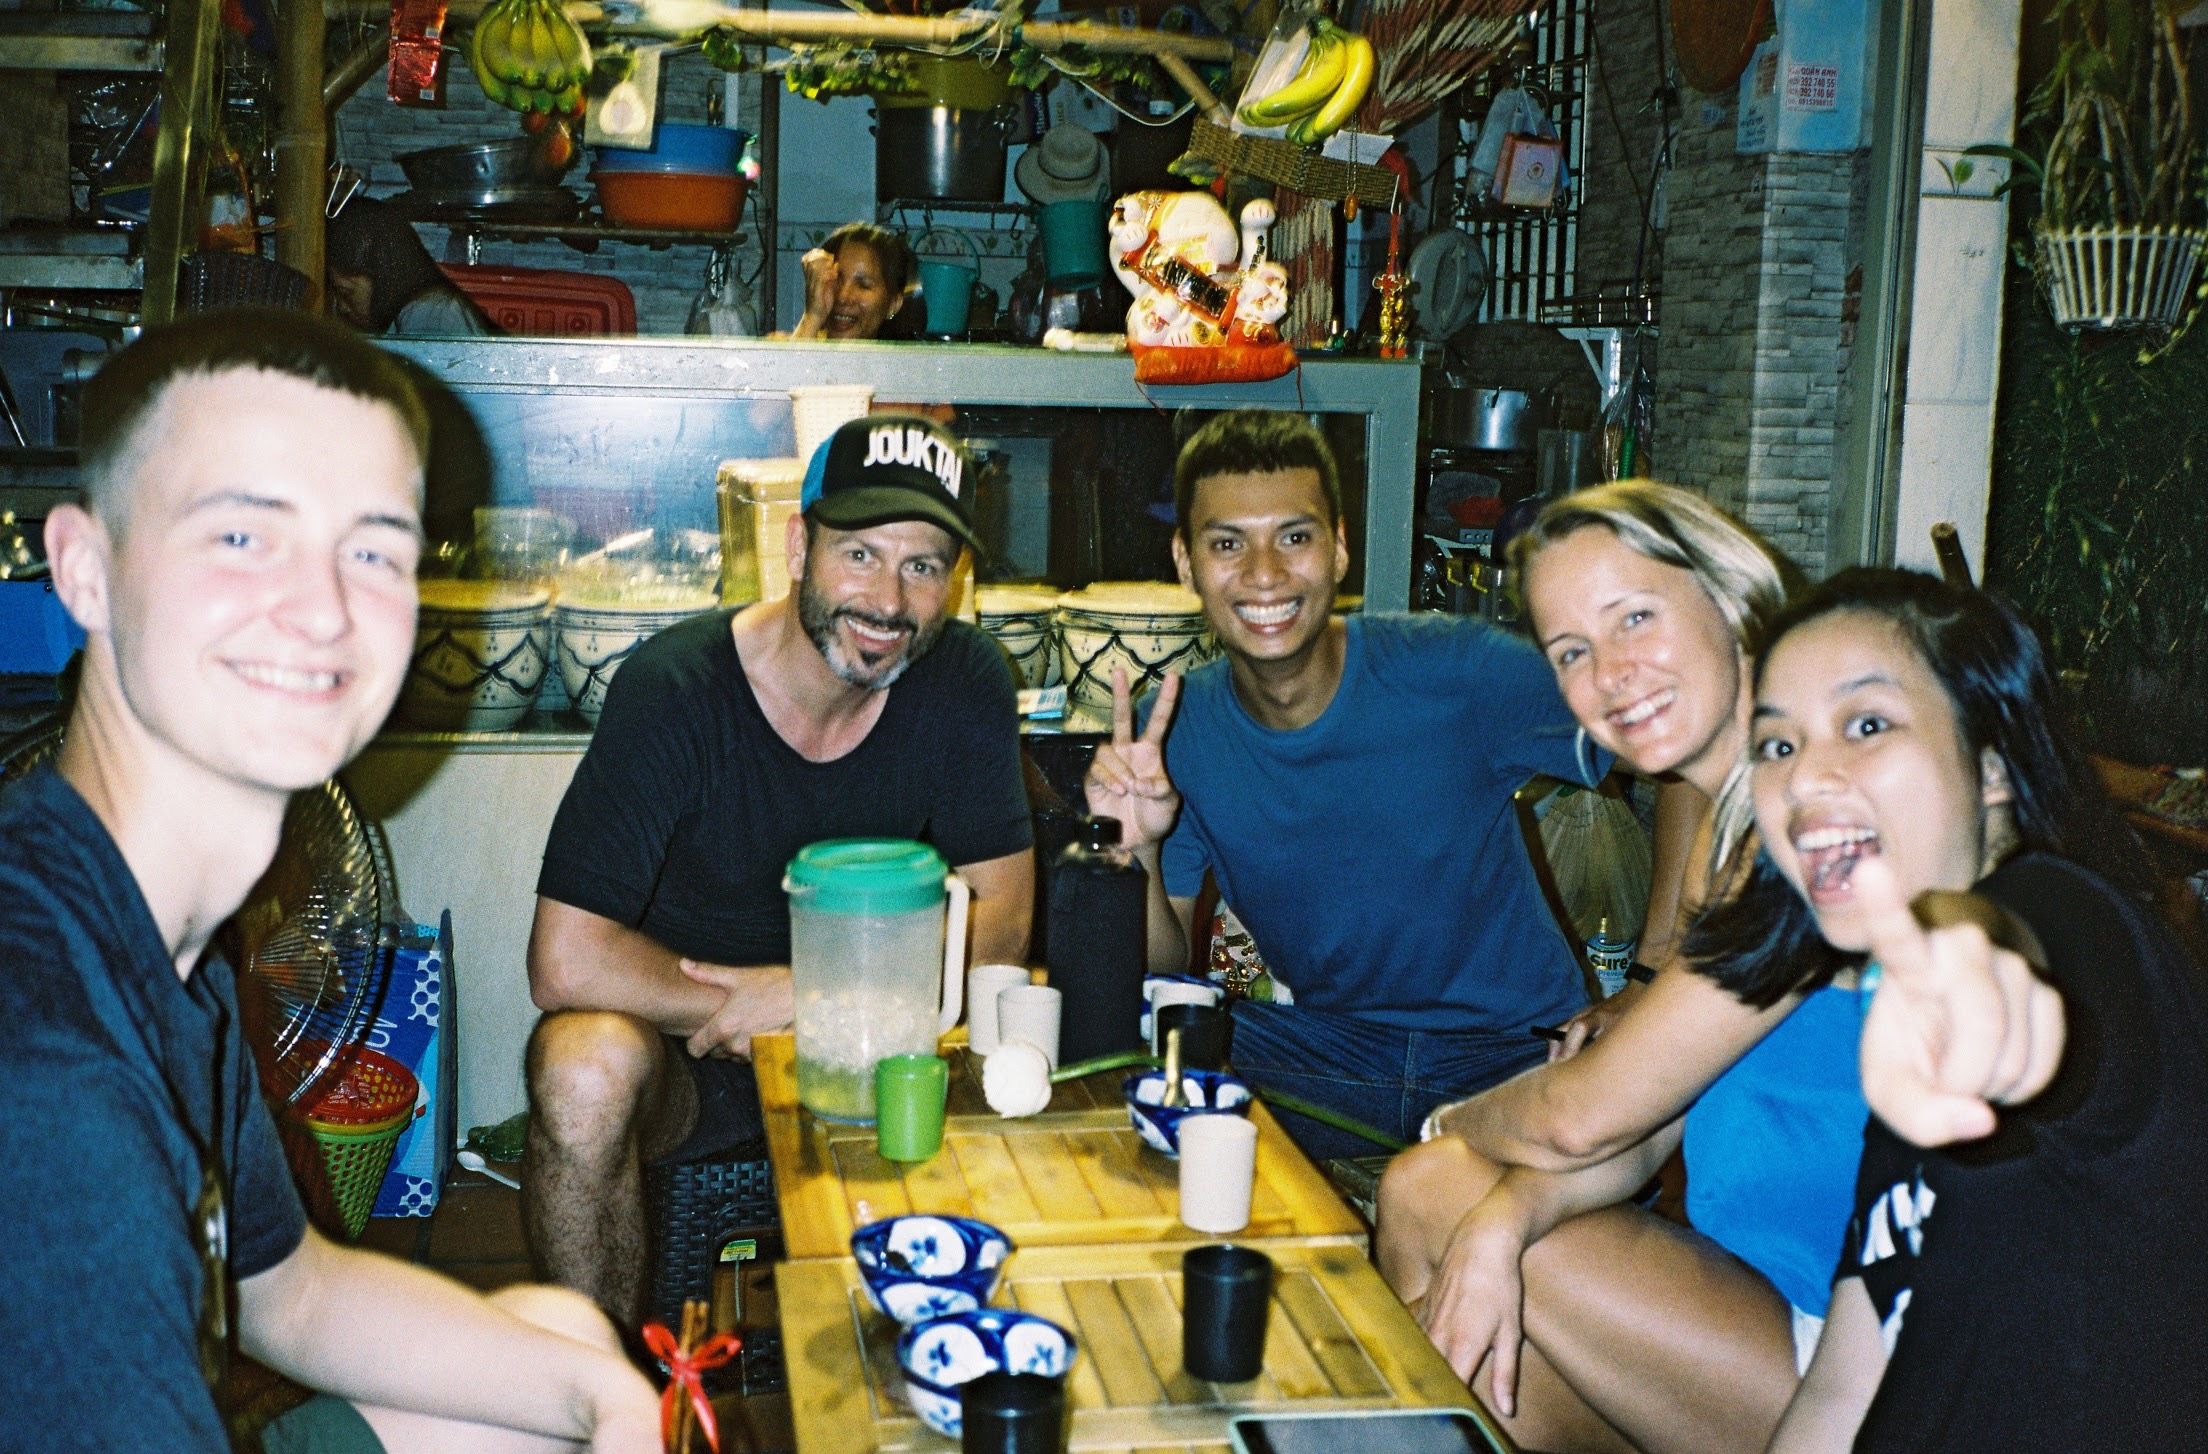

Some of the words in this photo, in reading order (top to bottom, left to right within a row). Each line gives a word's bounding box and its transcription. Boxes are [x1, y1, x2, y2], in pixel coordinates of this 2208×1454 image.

[1801, 77, 1812, 87] 392
[1827, 78, 1835, 88] 55
[1800, 87, 1812, 97] 392
